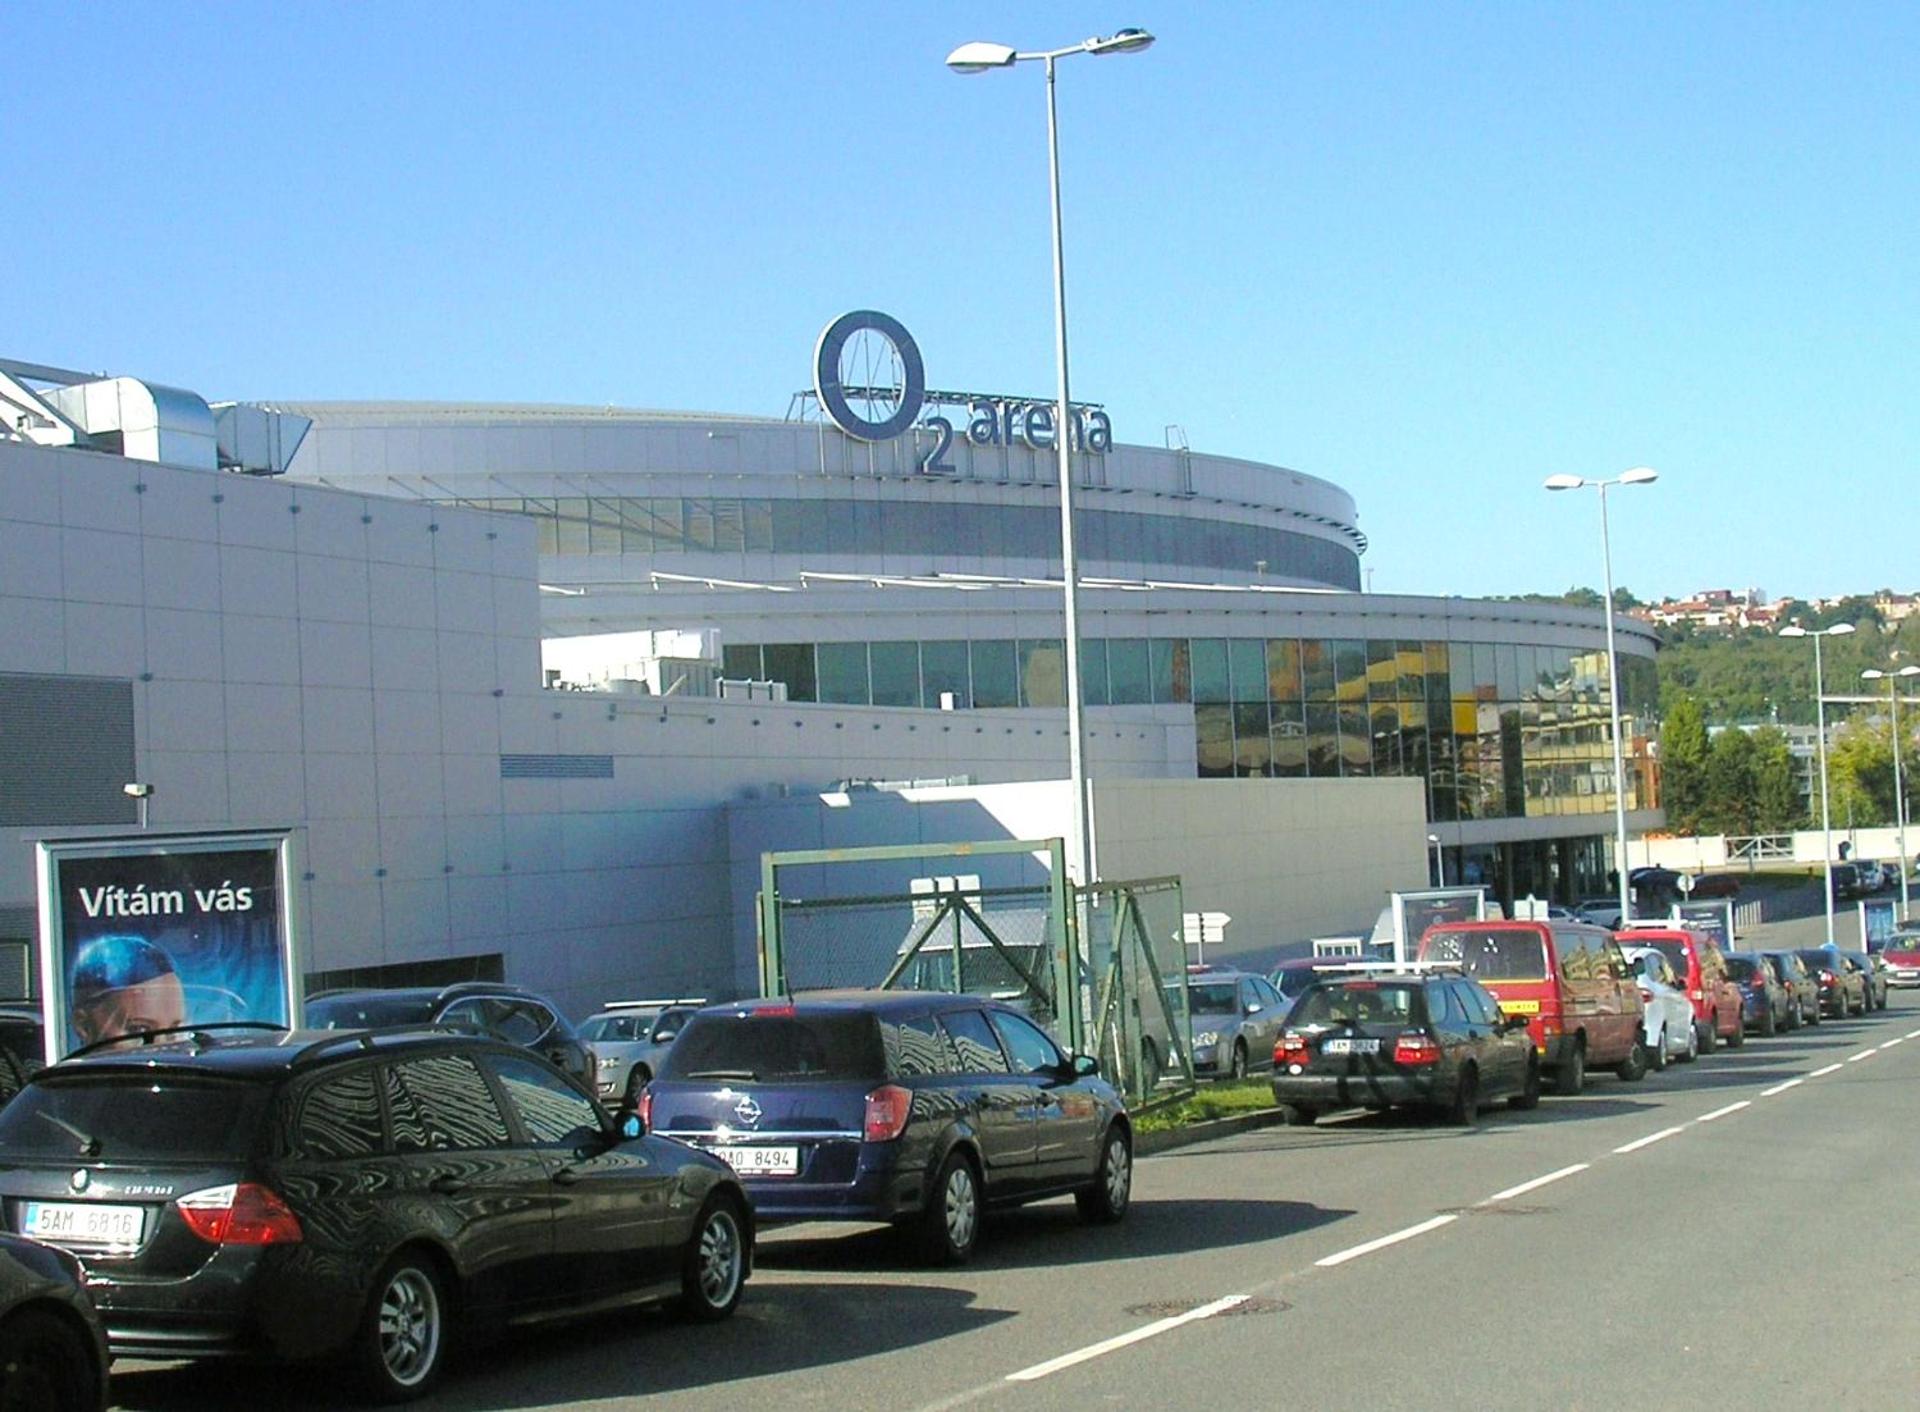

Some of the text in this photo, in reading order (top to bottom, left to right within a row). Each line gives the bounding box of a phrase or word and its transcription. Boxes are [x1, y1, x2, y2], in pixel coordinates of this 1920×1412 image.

[966, 402, 1112, 454] arena
[79, 880, 253, 917] Vítám vás
[755, 1151, 789, 1166] 8494
[41, 1209, 132, 1233] 5AM 6816
